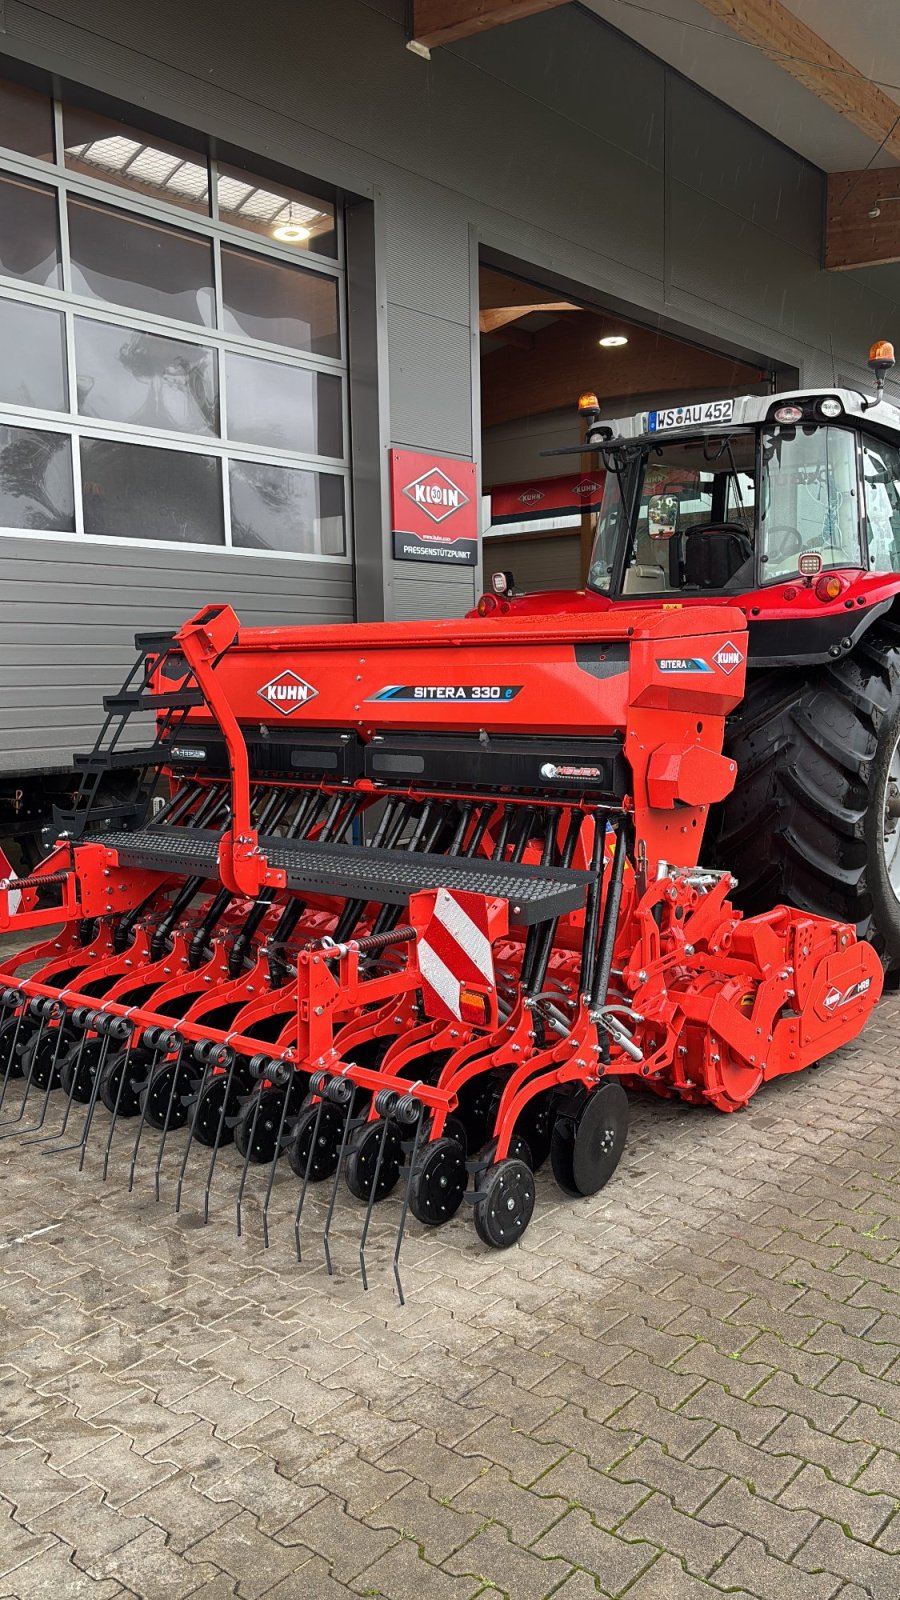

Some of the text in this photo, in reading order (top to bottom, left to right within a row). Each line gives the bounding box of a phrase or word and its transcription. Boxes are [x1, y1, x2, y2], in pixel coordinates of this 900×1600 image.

[657, 402, 731, 427] WS AU 452
[576, 484, 597, 492] KUHN
[522, 494, 541, 502] KUHN
[403, 545, 471, 558] PRESSENSTÜTZPUNKT
[717, 652, 739, 664] KUHN
[660, 660, 687, 669] SITERA
[267, 685, 308, 700] KUHN
[414, 687, 512, 698] SITERA 330 e
